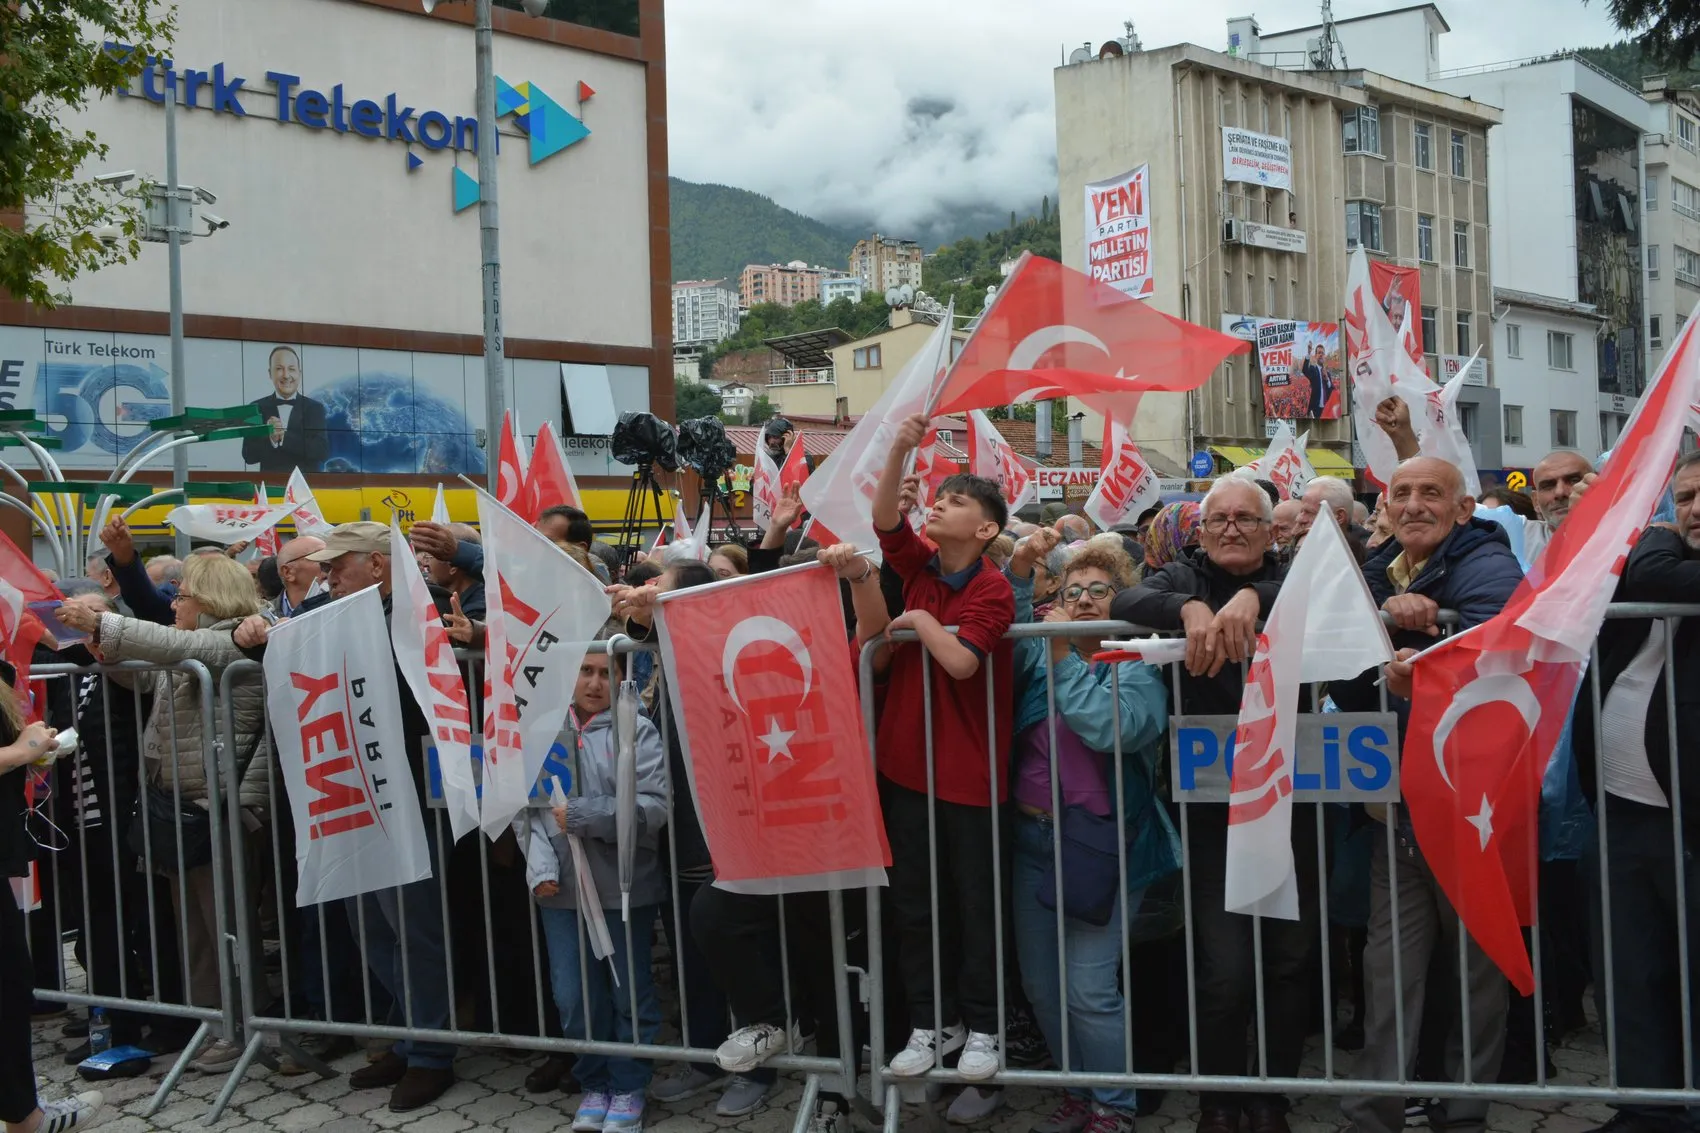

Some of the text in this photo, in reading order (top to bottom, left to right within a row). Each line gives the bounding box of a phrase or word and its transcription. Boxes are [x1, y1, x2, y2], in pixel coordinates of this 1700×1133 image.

[1091, 173, 1143, 227] YENİ
[1099, 218, 1138, 237] PARTİ
[1091, 231, 1146, 262] MİLLETİN
[1093, 252, 1144, 282] PARTİSİ
[45, 340, 156, 359] Türk Telekom
[1261, 348, 1292, 366] YENİ
[737, 625, 849, 827] YENİ
